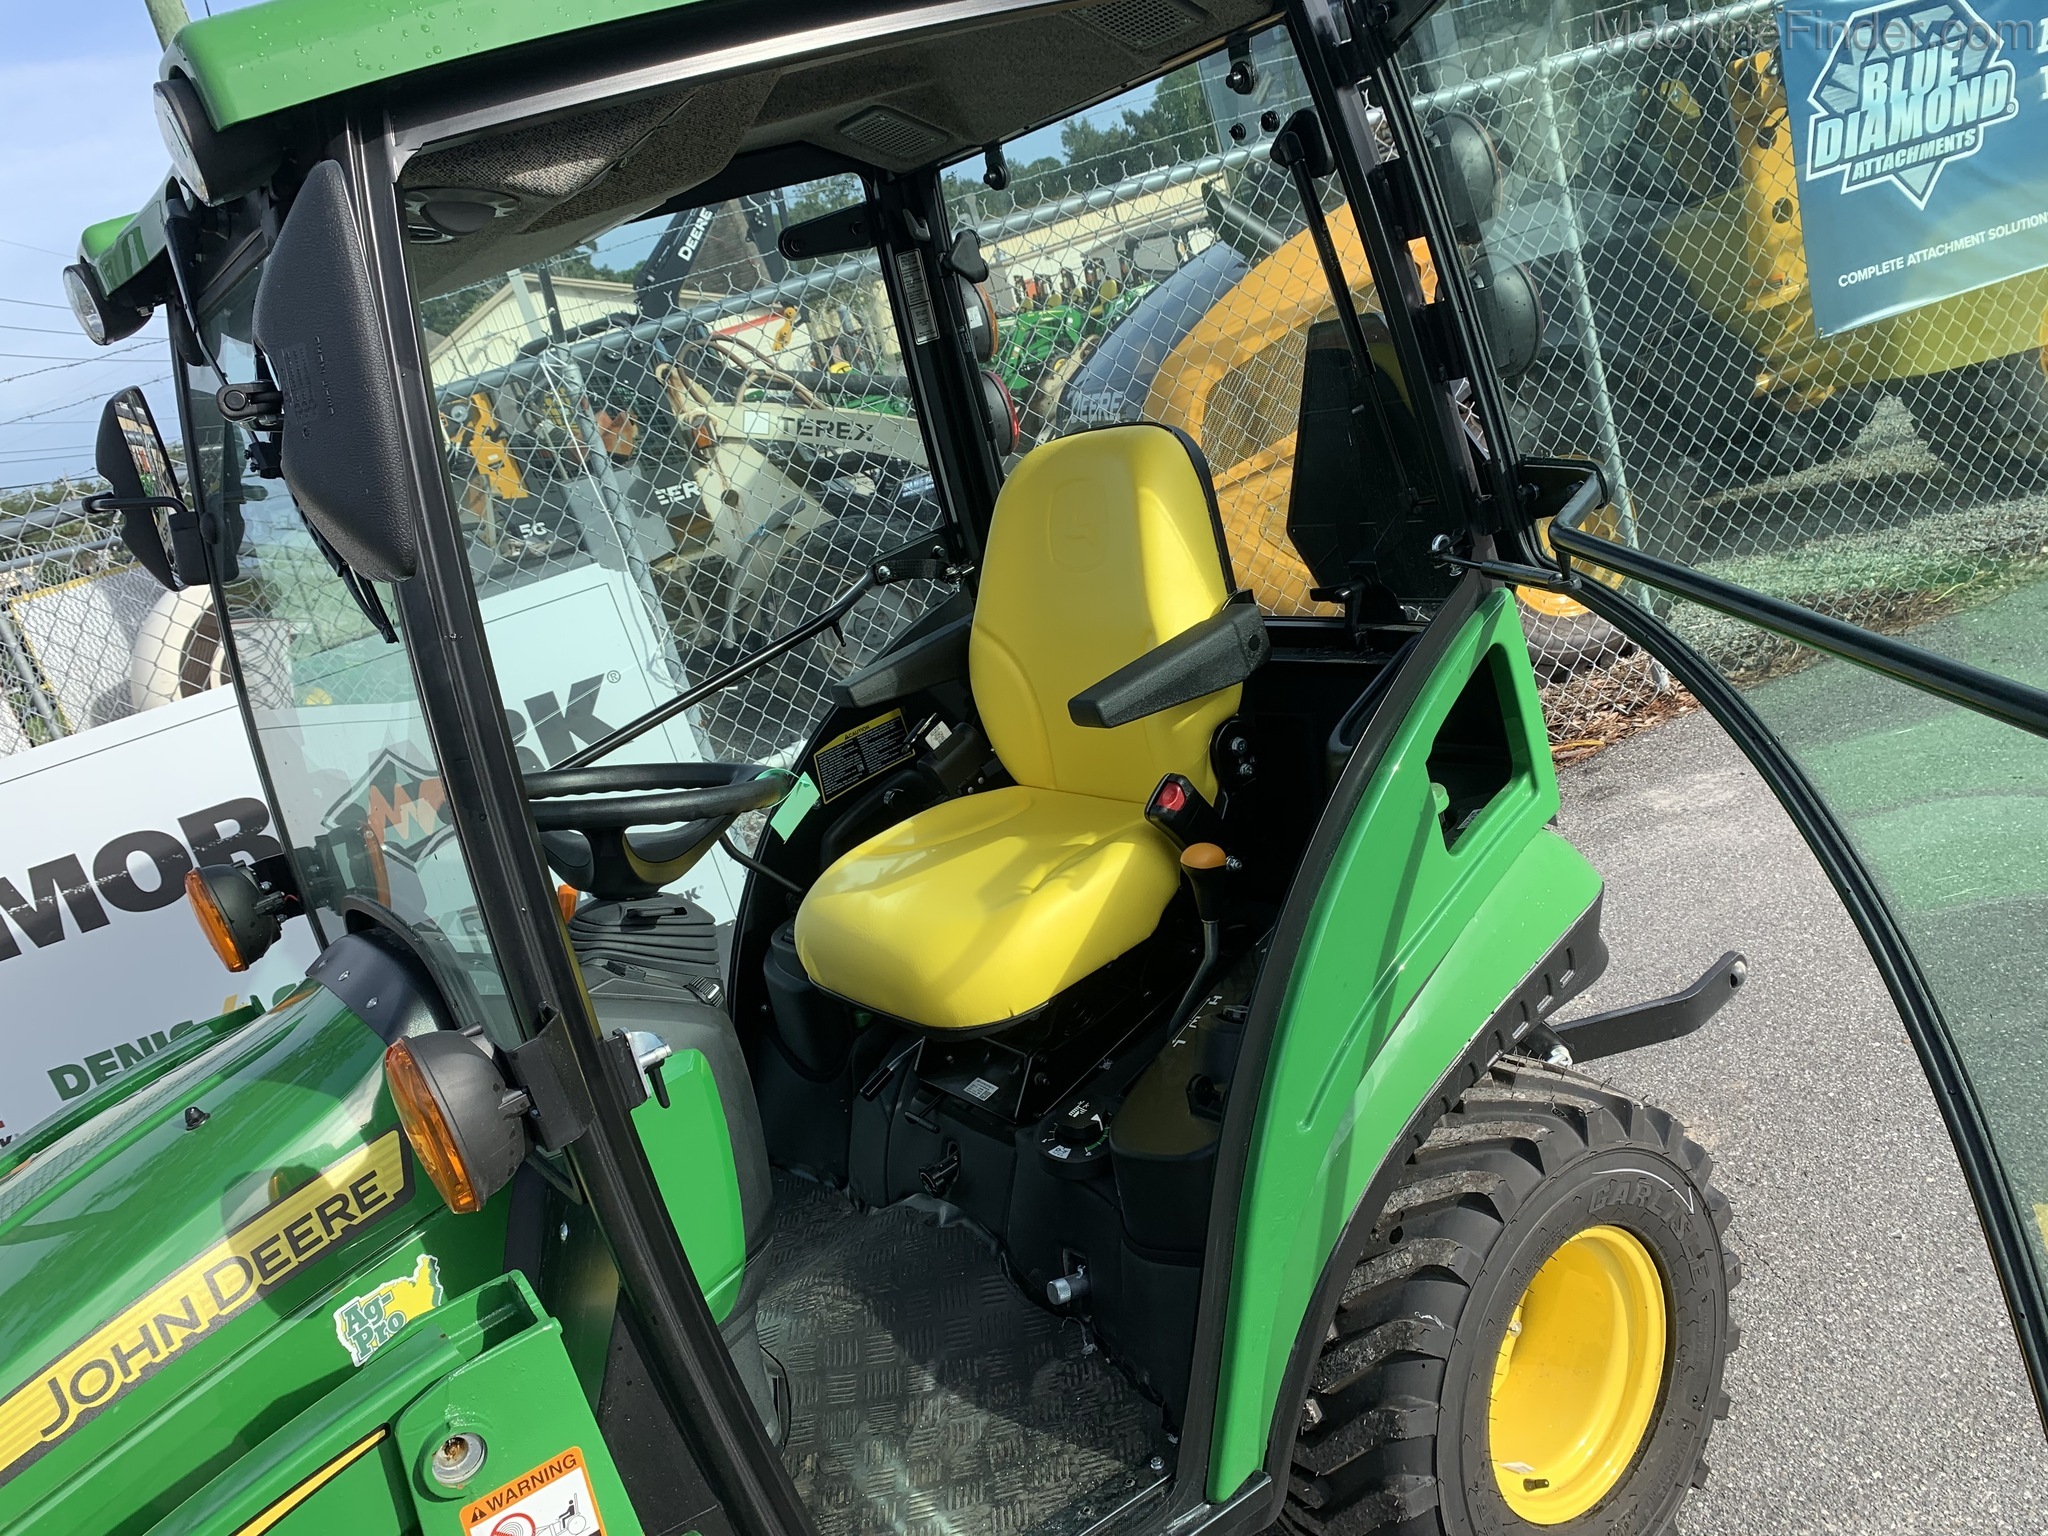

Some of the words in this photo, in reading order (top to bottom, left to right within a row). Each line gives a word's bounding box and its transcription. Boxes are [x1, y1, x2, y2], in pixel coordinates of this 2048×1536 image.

[1861, 40, 1960, 111] BLUE
[1814, 69, 2009, 168] DIAMOND
[1851, 127, 1977, 181] ATTACHMENTS
[678, 206, 713, 262] DEERE
[1838, 256, 1905, 288] COMPLETE
[1907, 230, 1987, 267] ATTACHMENT
[1988, 211, 2048, 241] SOLUTION
[777, 416, 874, 442] TEREX
[1588, 1180, 1709, 1286] CARLISLE
[40, 1294, 202, 1438] JOHN
[203, 1169, 380, 1310] DEERE
[351, 1312, 406, 1362] Pro
[485, 1453, 577, 1511] WARNING
